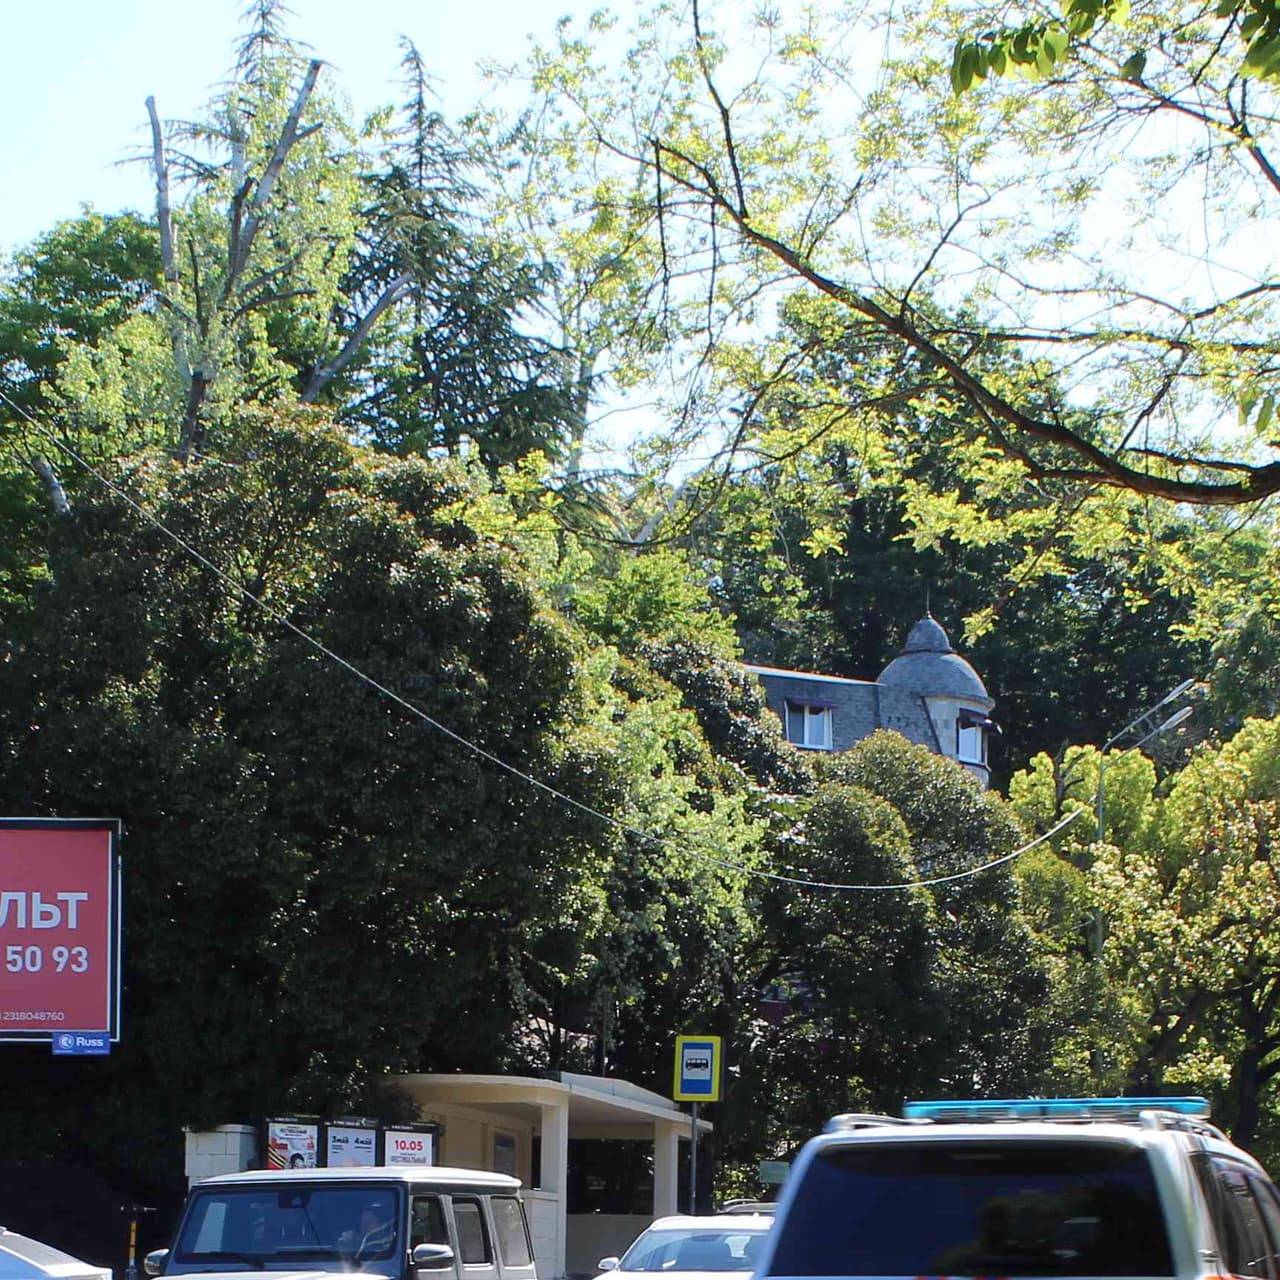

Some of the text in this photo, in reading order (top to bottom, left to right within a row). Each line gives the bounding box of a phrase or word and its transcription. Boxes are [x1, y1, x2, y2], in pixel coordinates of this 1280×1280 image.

[6, 946, 42, 972] 50
[51, 946, 89, 973] 93
[76, 1036, 104, 1047] Russ
[394, 1140, 424, 1151] 10.05
